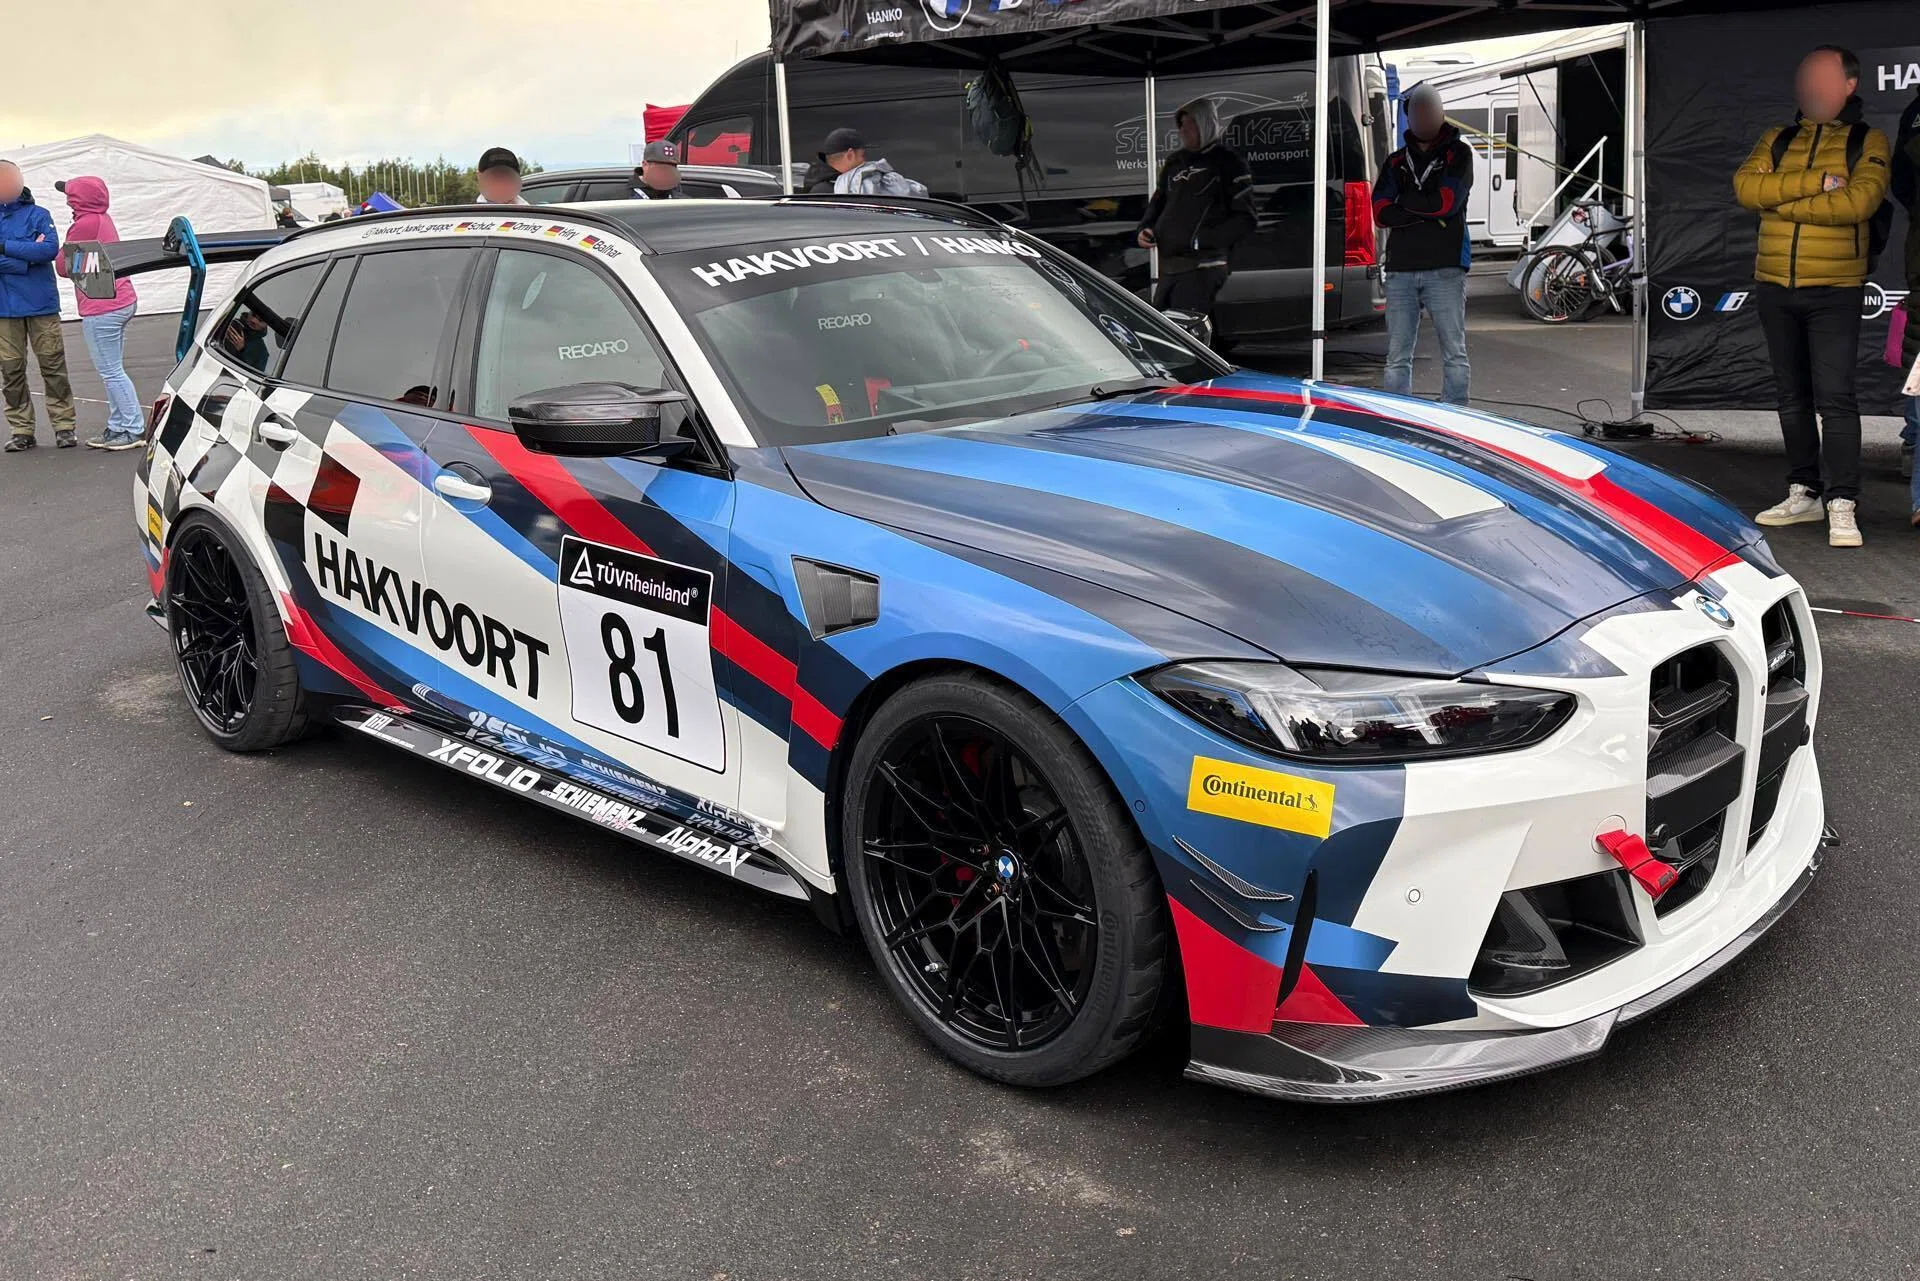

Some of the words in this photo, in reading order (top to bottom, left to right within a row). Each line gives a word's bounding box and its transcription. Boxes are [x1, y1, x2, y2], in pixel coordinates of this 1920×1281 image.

[867, 8, 903, 25] HANKO
[1247, 149, 1310, 162] Motorsport
[690, 238, 908, 287] HAKVOORT
[936, 237, 1042, 258] HANKO
[1863, 295, 1882, 306] INI
[817, 313, 872, 330] RECARO
[557, 338, 629, 361] RECARO
[314, 532, 550, 700] HAKVOORT
[600, 611, 680, 739] 81
[427, 738, 541, 792] XFOLIO
[552, 781, 647, 824] SCHIEMENZ
[1202, 774, 1302, 809] Continental
